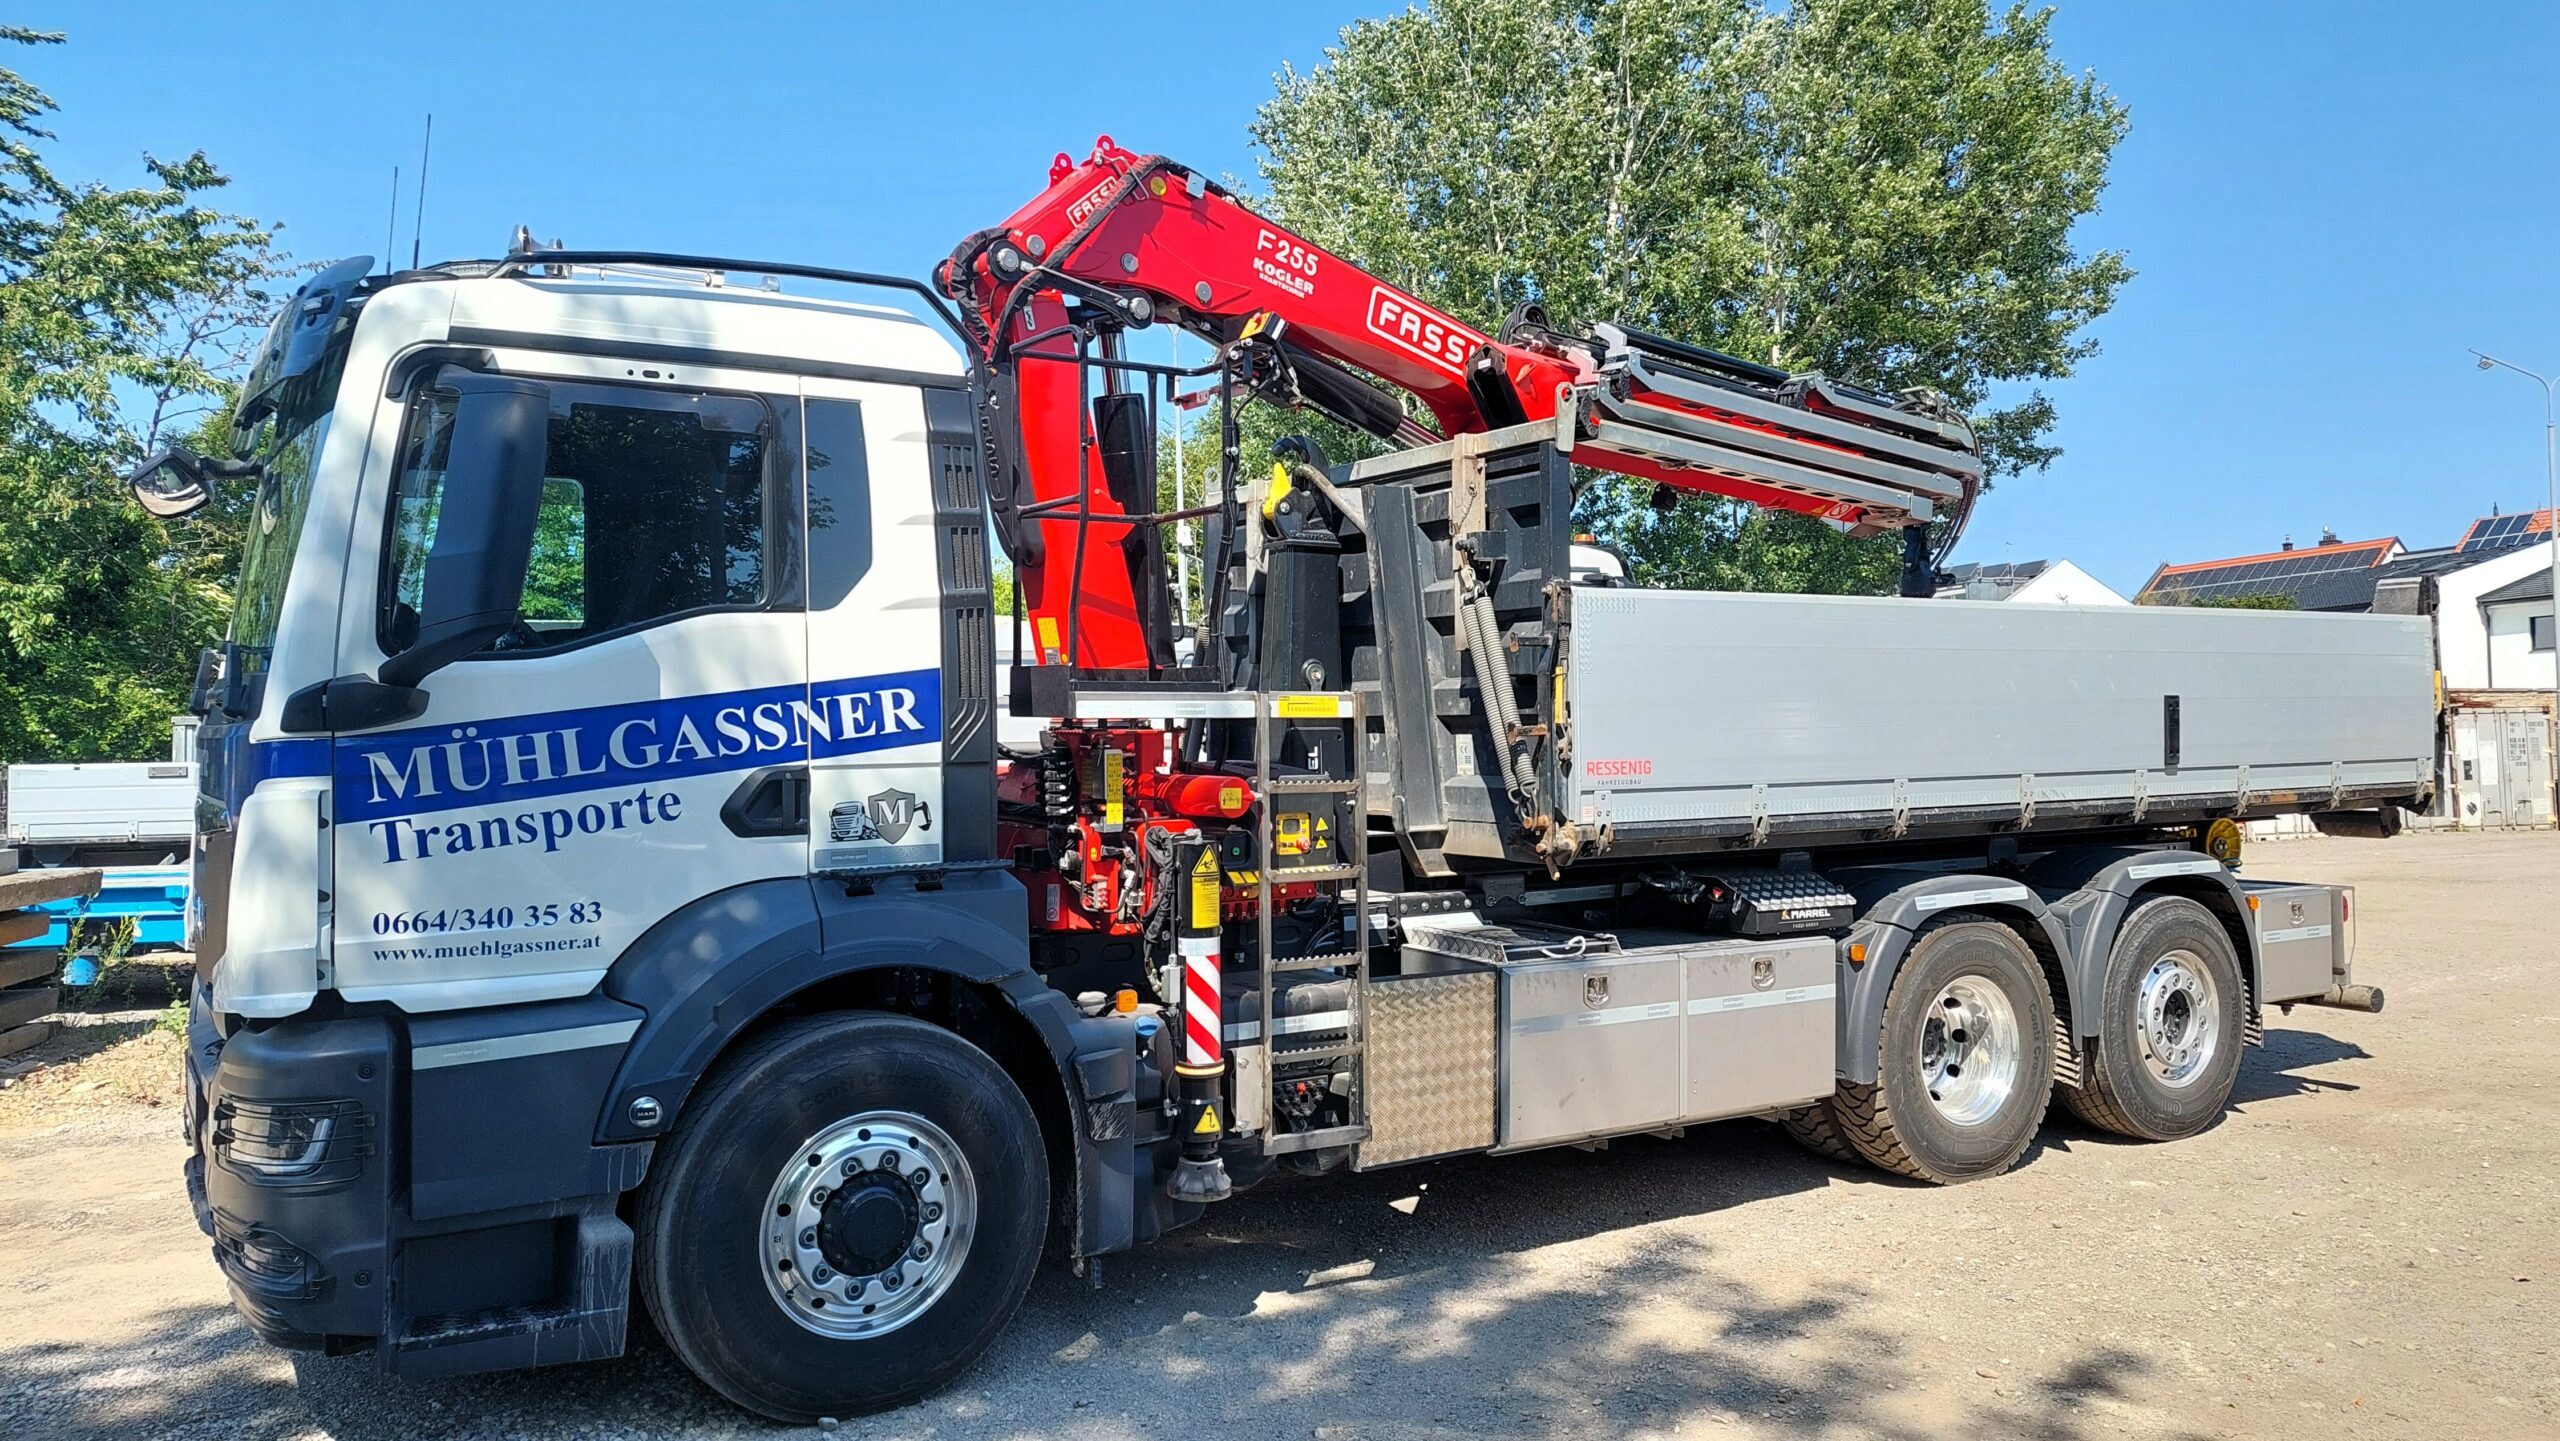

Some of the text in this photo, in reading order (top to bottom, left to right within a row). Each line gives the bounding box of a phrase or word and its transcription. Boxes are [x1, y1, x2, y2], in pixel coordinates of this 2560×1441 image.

[1253, 257, 1315, 295] KOGLER
[361, 687, 925, 804] MÜHLGASSNER
[1586, 760, 1652, 776] RESSENIG
[369, 787, 682, 864] Transporte
[875, 798, 909, 826] M
[373, 901, 602, 935] 0664/340 35 83
[1790, 908, 1831, 920] MARREL
[373, 935, 602, 961] www.muehlgassner.at
